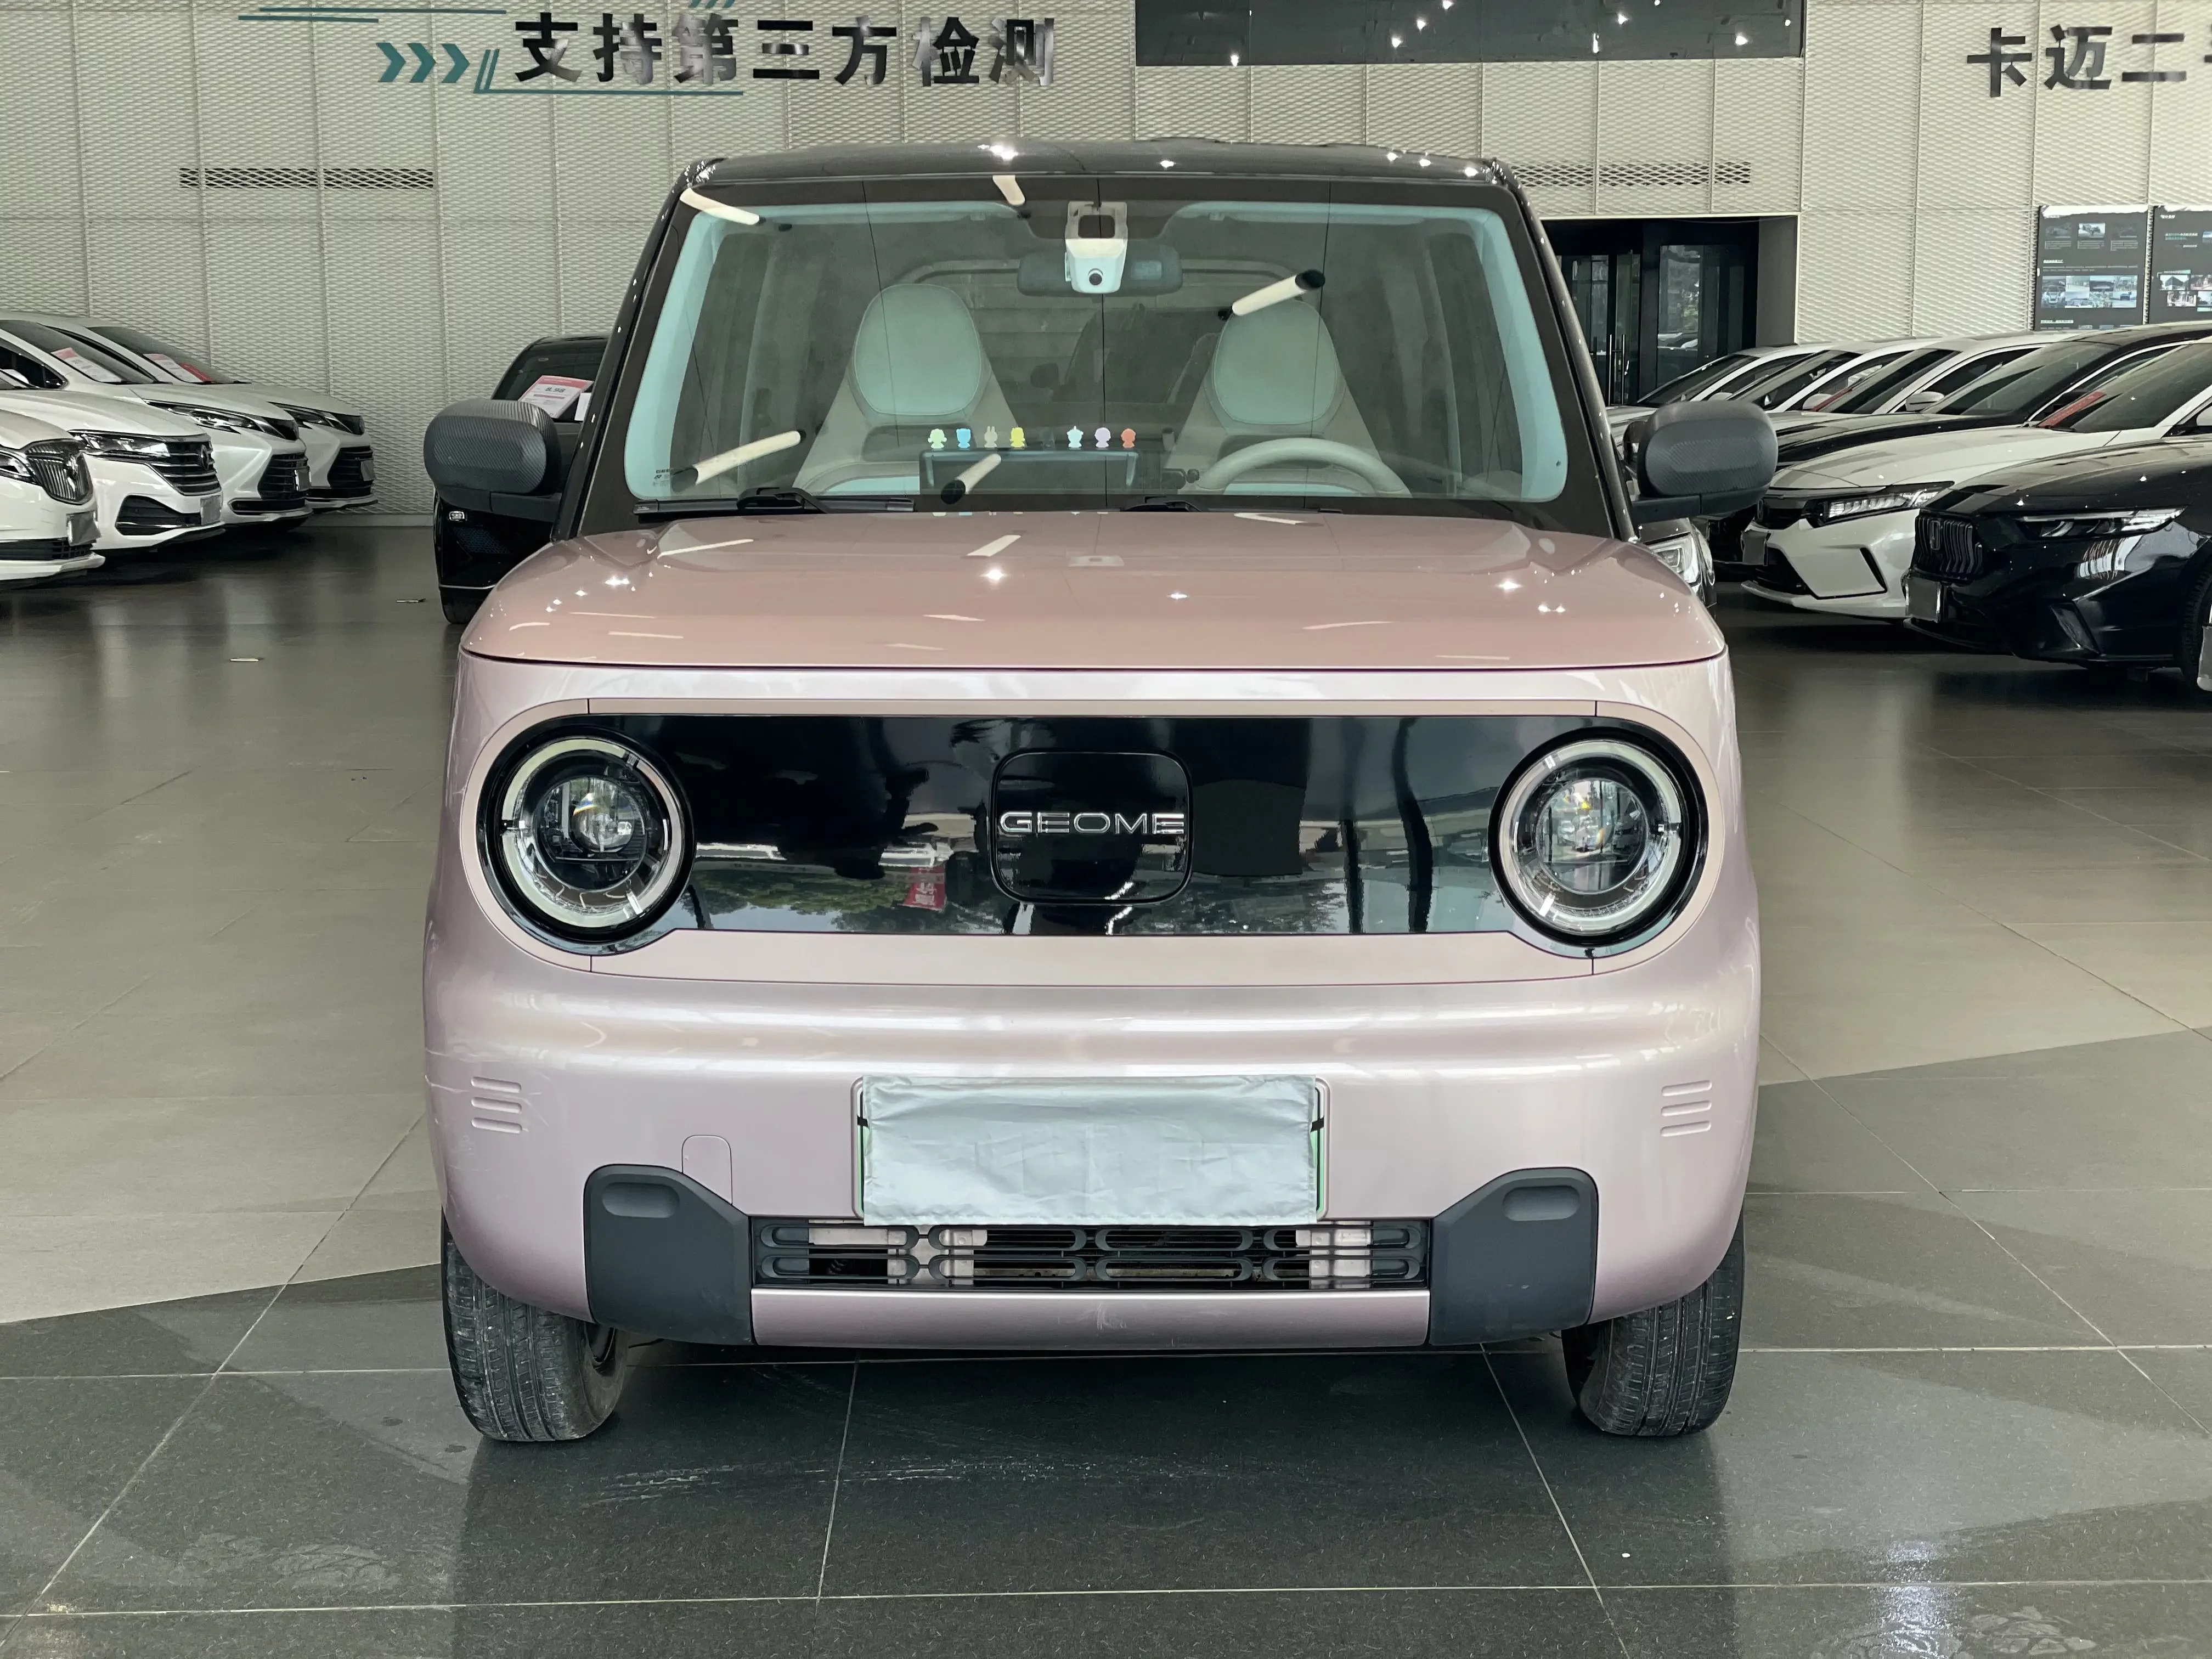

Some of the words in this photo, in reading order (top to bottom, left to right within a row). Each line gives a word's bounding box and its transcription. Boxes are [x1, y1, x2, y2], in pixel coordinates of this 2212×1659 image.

[515, 12, 1054, 86] 支持第三方检测
[1967, 24, 2212, 98] 卡迈二
[1000, 811, 1184, 834] GEOME
